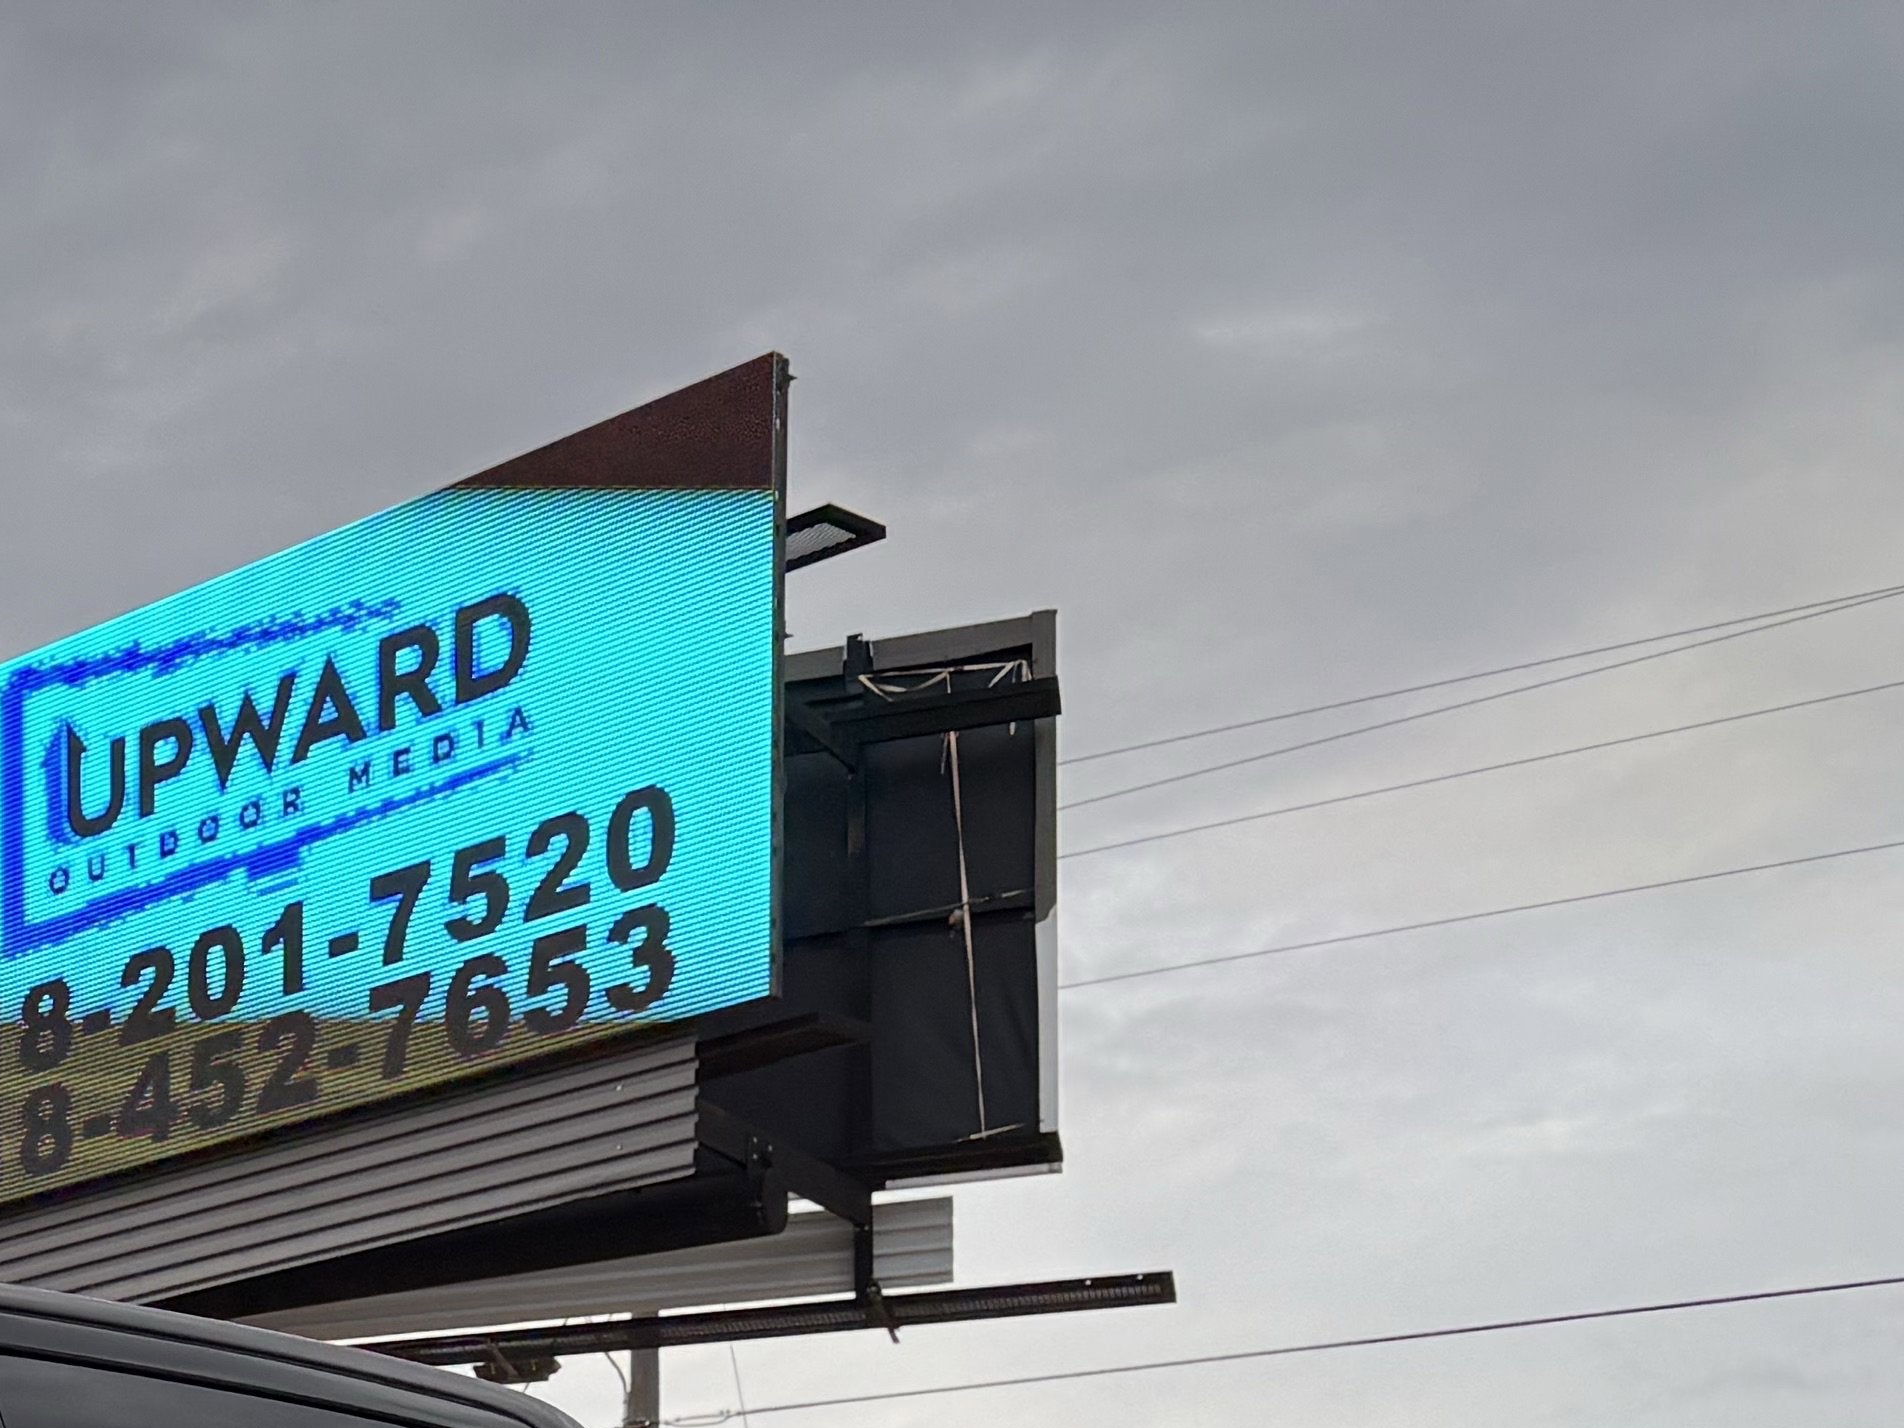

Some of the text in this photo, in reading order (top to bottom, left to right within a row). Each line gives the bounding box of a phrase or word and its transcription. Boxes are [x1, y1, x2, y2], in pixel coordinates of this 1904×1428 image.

[48, 706, 531, 895] OUTDOOR MEDIA
[65, 592, 532, 838] UPWARD
